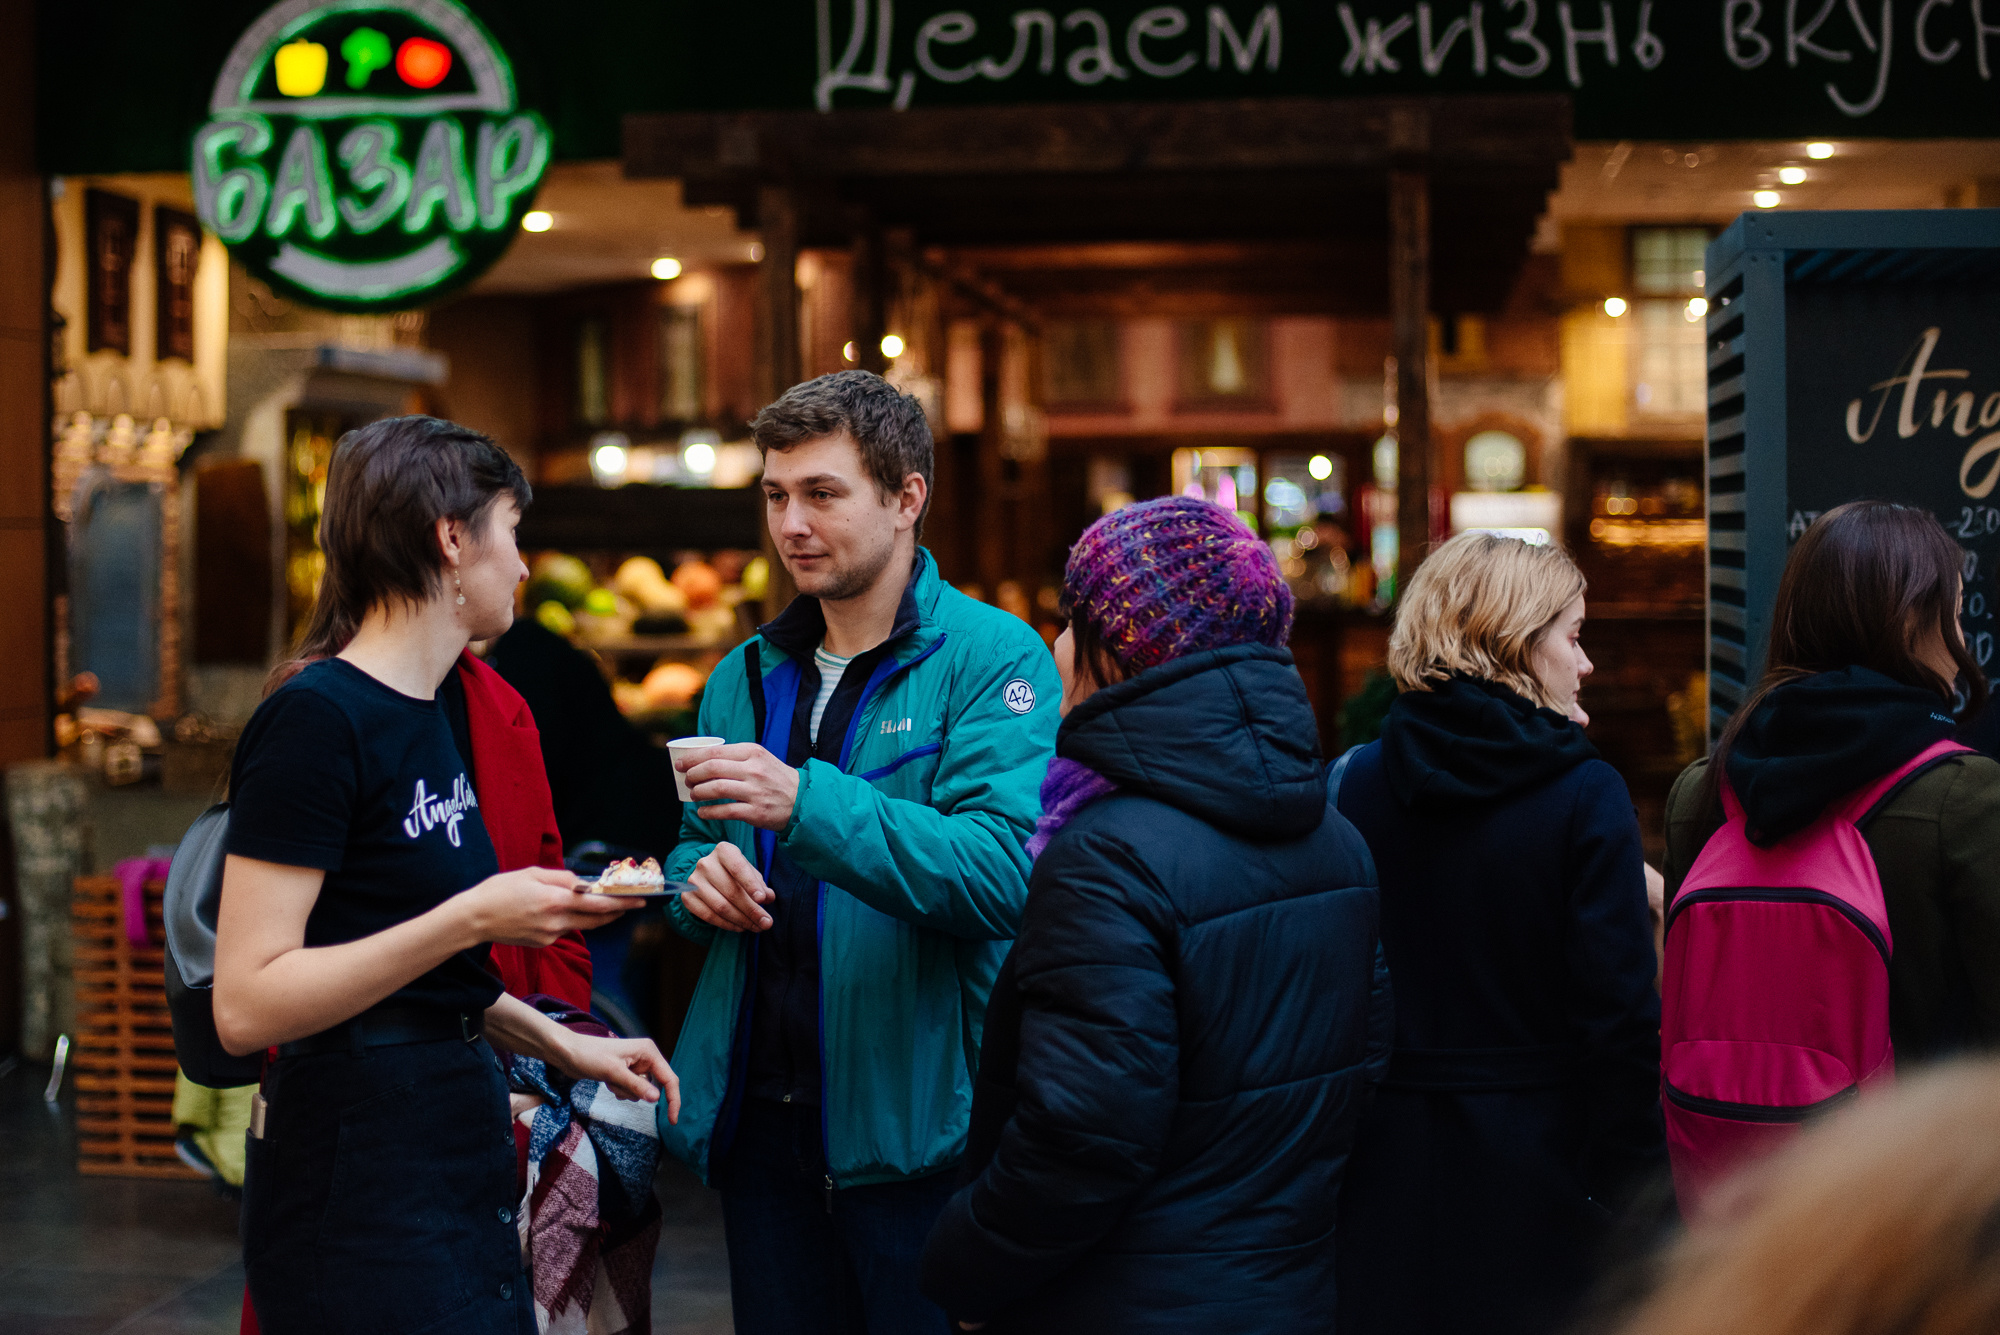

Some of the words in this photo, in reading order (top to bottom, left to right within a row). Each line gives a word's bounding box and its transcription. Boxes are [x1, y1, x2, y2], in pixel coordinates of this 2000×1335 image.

[814, 0, 1282, 113] Делаем
[1335, 0, 1664, 87] жизнь
[1008, 685, 1032, 705] 42
